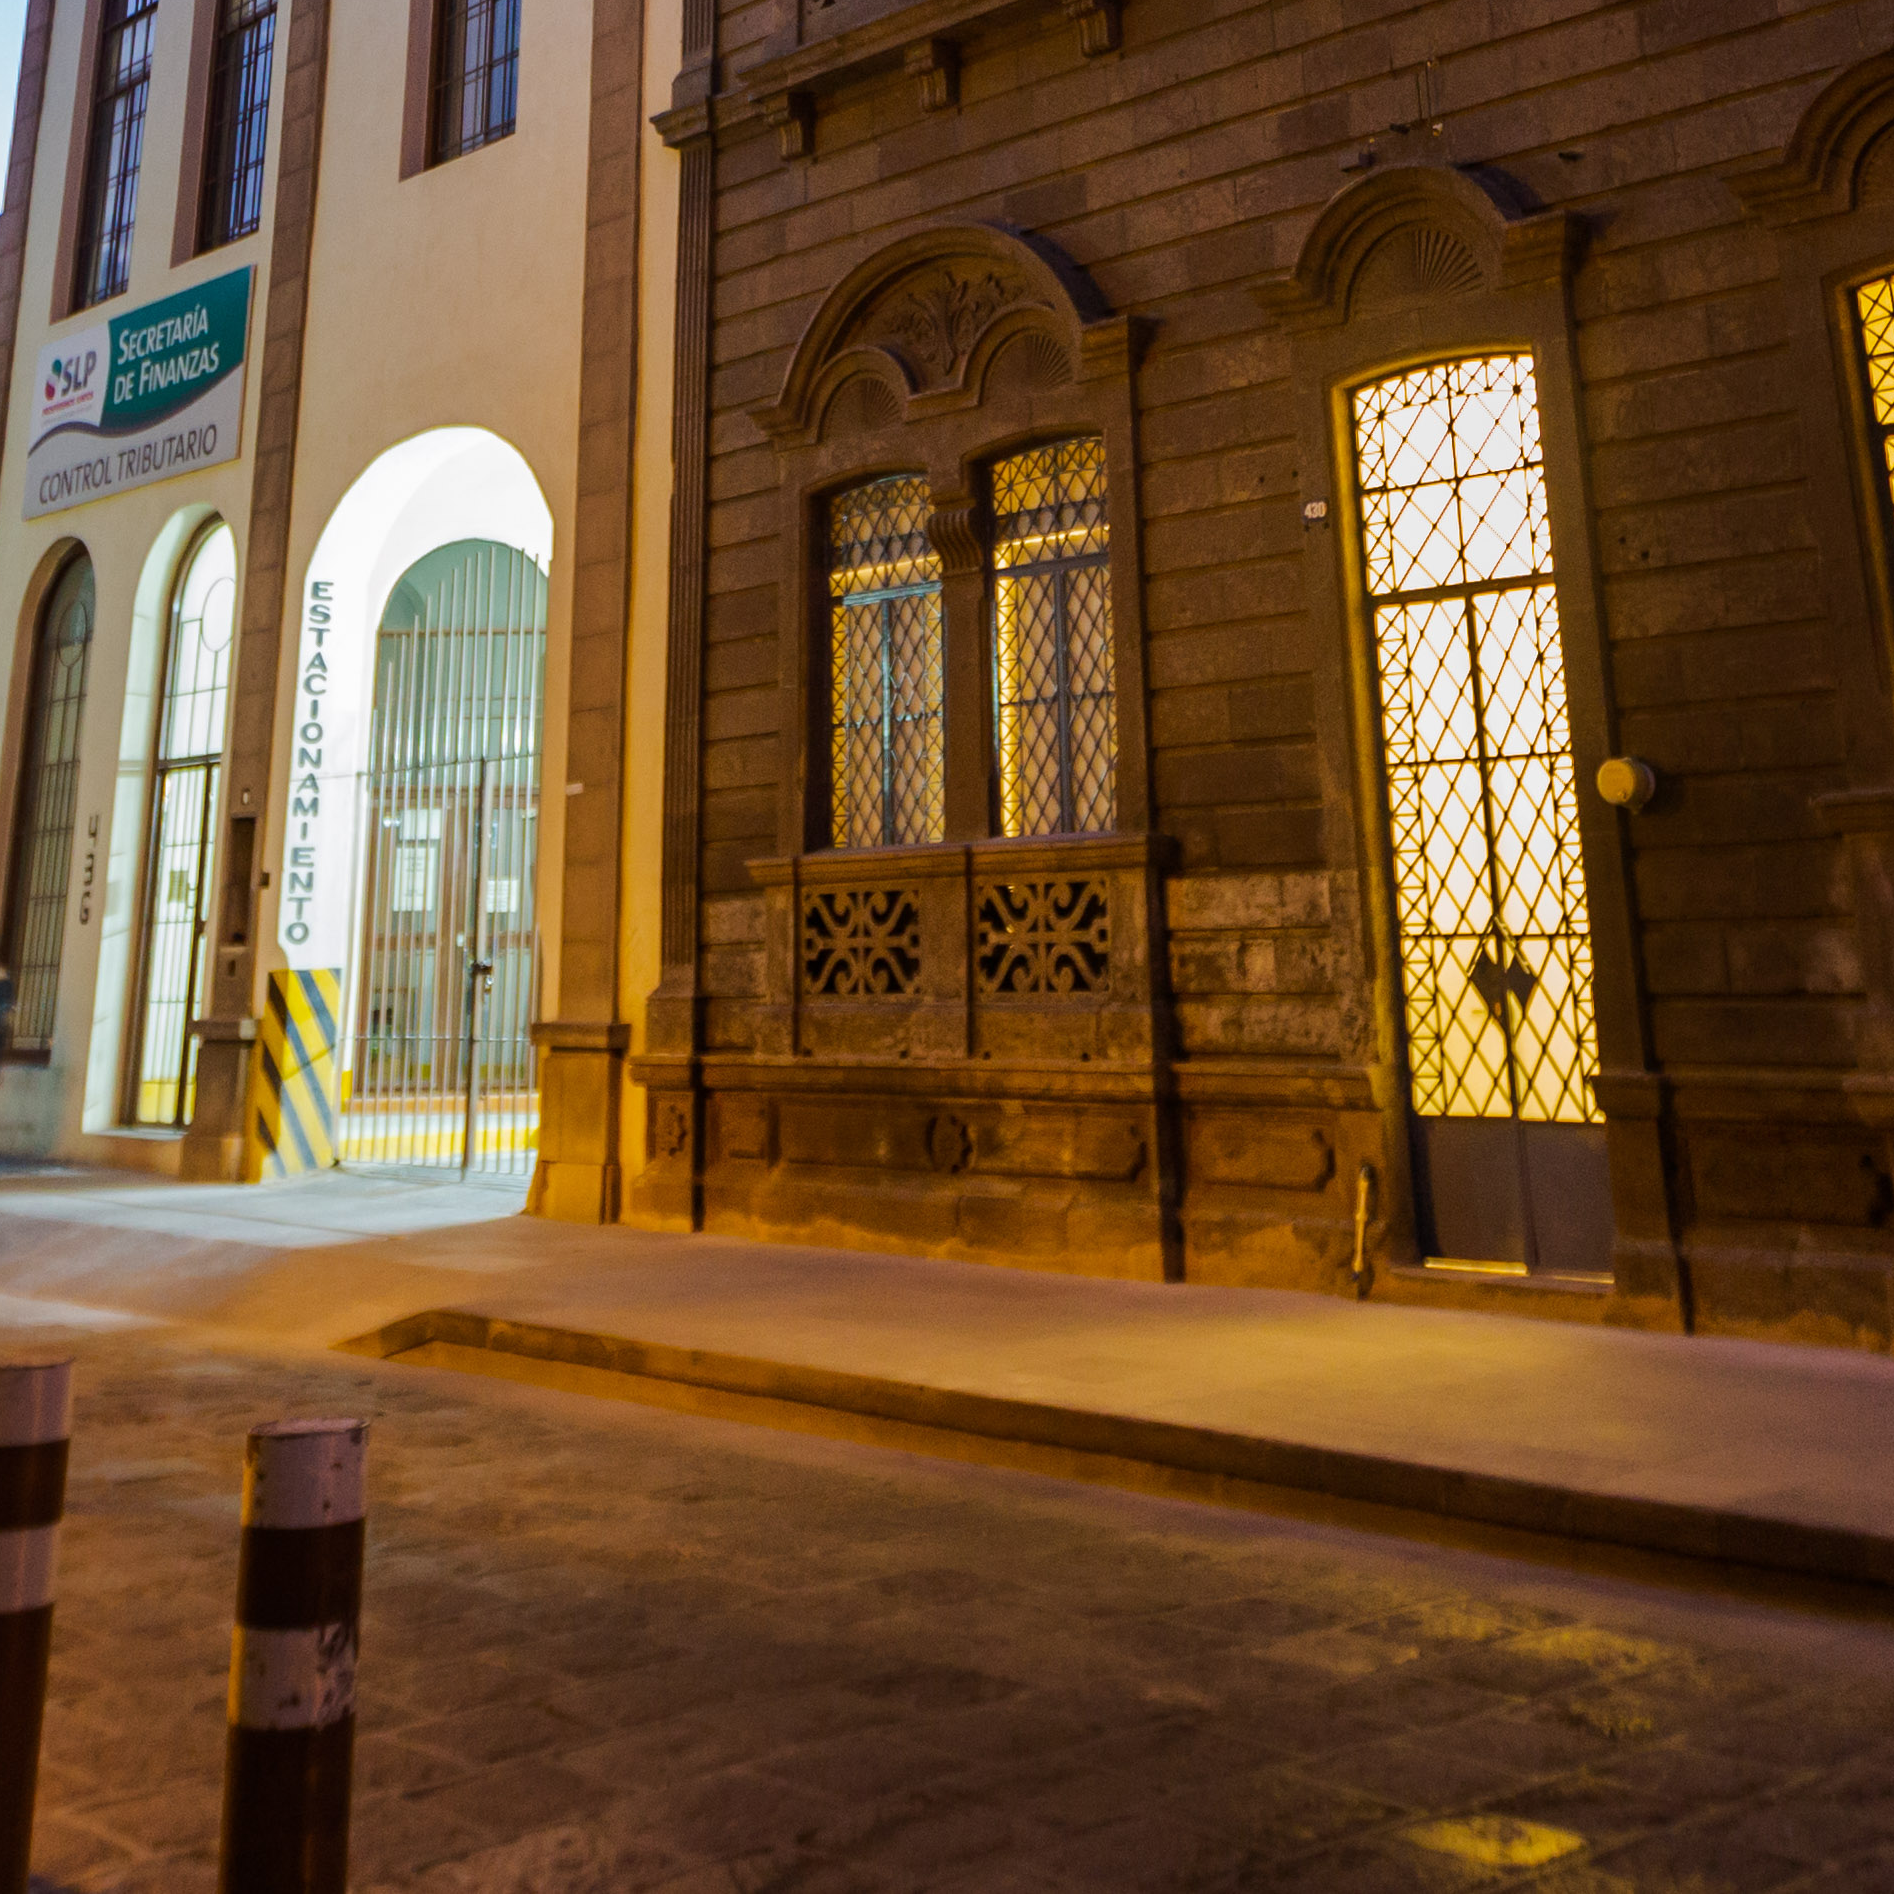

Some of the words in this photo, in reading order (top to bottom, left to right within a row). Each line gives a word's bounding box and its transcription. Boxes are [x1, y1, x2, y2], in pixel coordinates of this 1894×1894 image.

[118, 304, 208, 365] SECRETARÍA
[61, 351, 97, 397] SLP
[114, 372, 135, 405] DE
[139, 343, 219, 396] FINANZAS
[39, 458, 112, 505] CONTROL
[117, 424, 217, 481] TRIBUTARIO
[1304, 501, 1327, 519] 430
[285, 581, 334, 945] ESTACIONAMIENTO
